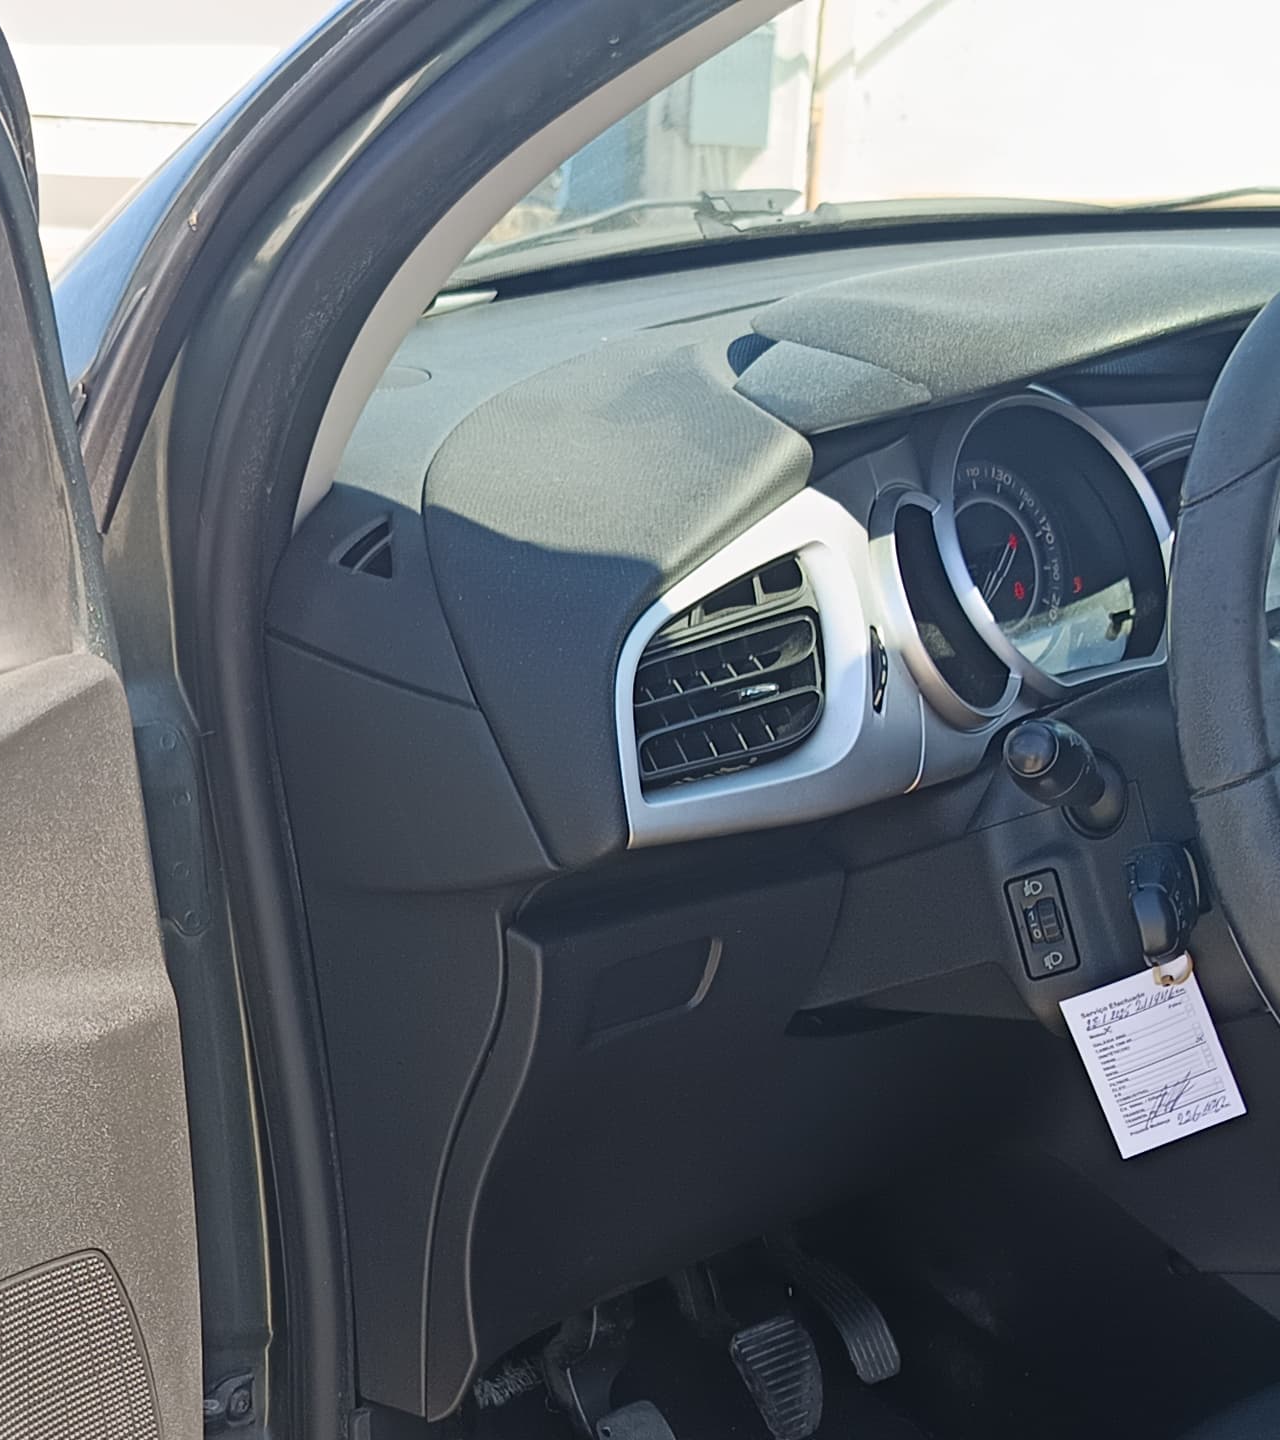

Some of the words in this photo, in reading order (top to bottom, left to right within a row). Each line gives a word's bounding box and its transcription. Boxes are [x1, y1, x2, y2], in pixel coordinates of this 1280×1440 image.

[991, 465, 1012, 485] 130
[1039, 517, 1055, 545] 170
[1049, 593, 1061, 621] 210
